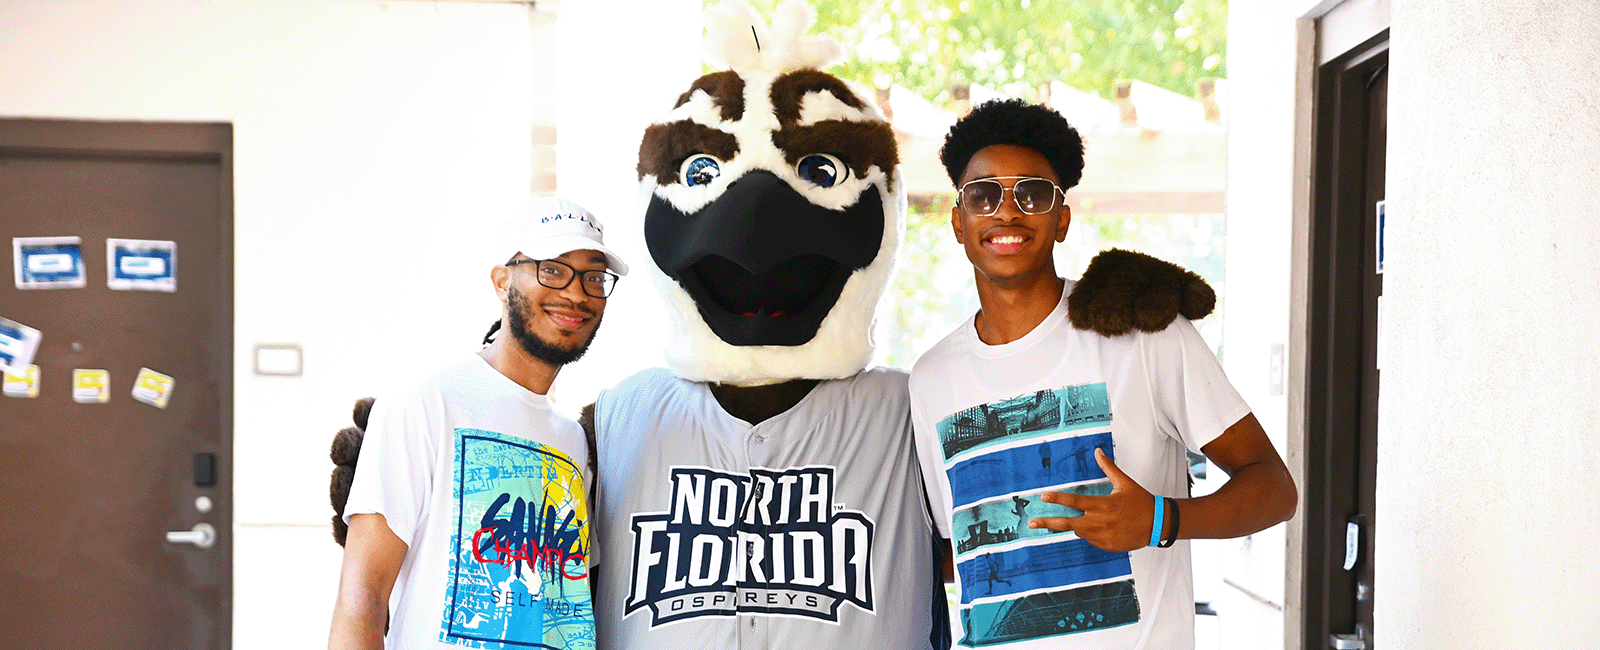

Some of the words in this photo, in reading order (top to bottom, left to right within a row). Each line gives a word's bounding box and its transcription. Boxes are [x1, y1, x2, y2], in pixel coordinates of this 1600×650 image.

[671, 472, 829, 528] NORTH
[630, 517, 868, 607] FLORIDA
[490, 589, 539, 608] SELF
[545, 597, 584, 617] MADE
[671, 592, 818, 611] OSPREYS
